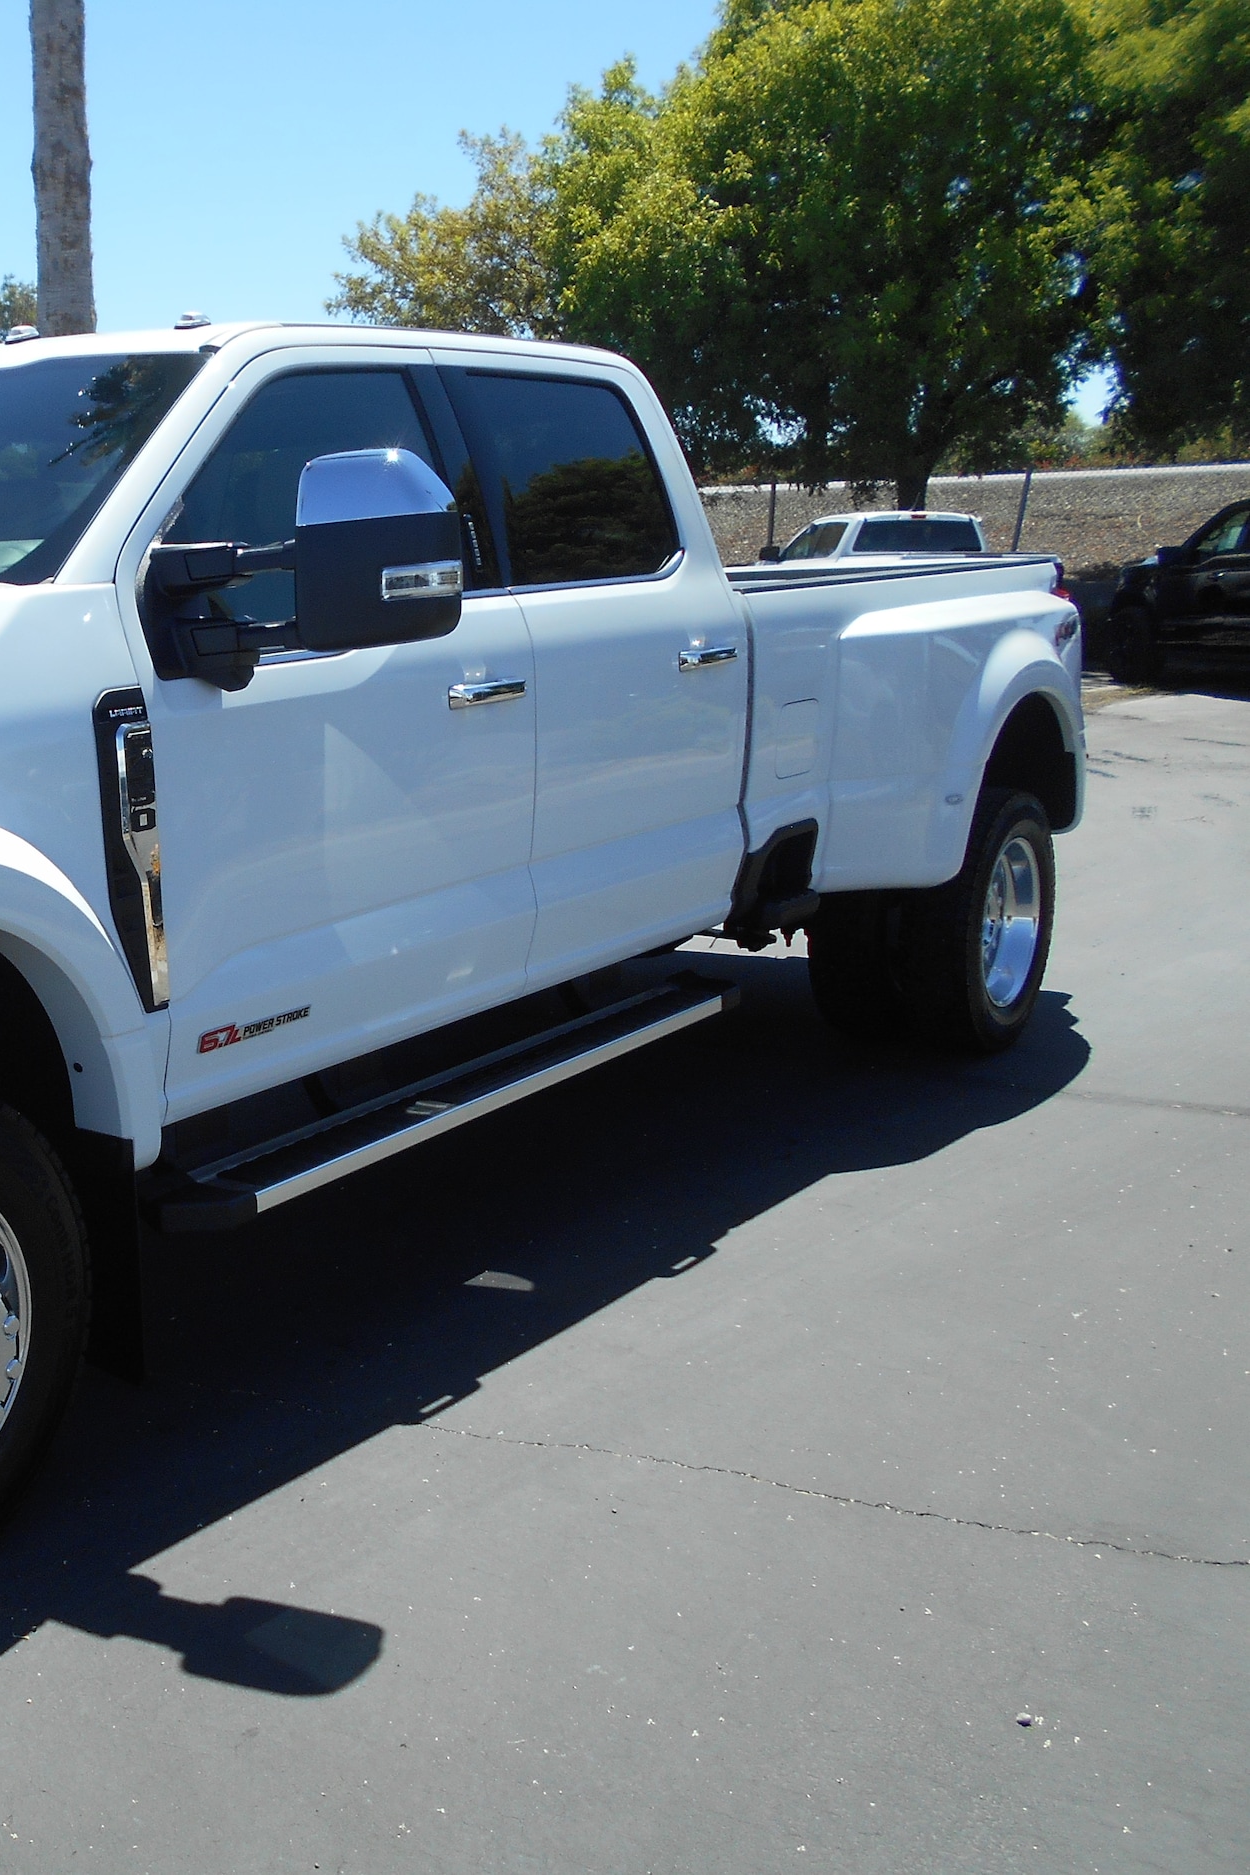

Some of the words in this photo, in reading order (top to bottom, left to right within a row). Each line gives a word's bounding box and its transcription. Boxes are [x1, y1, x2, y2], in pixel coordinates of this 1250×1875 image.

[199, 1024, 242, 1054] 6.7L
[242, 1016, 275, 1037] POWER
[275, 1006, 311, 1026] STROKE
